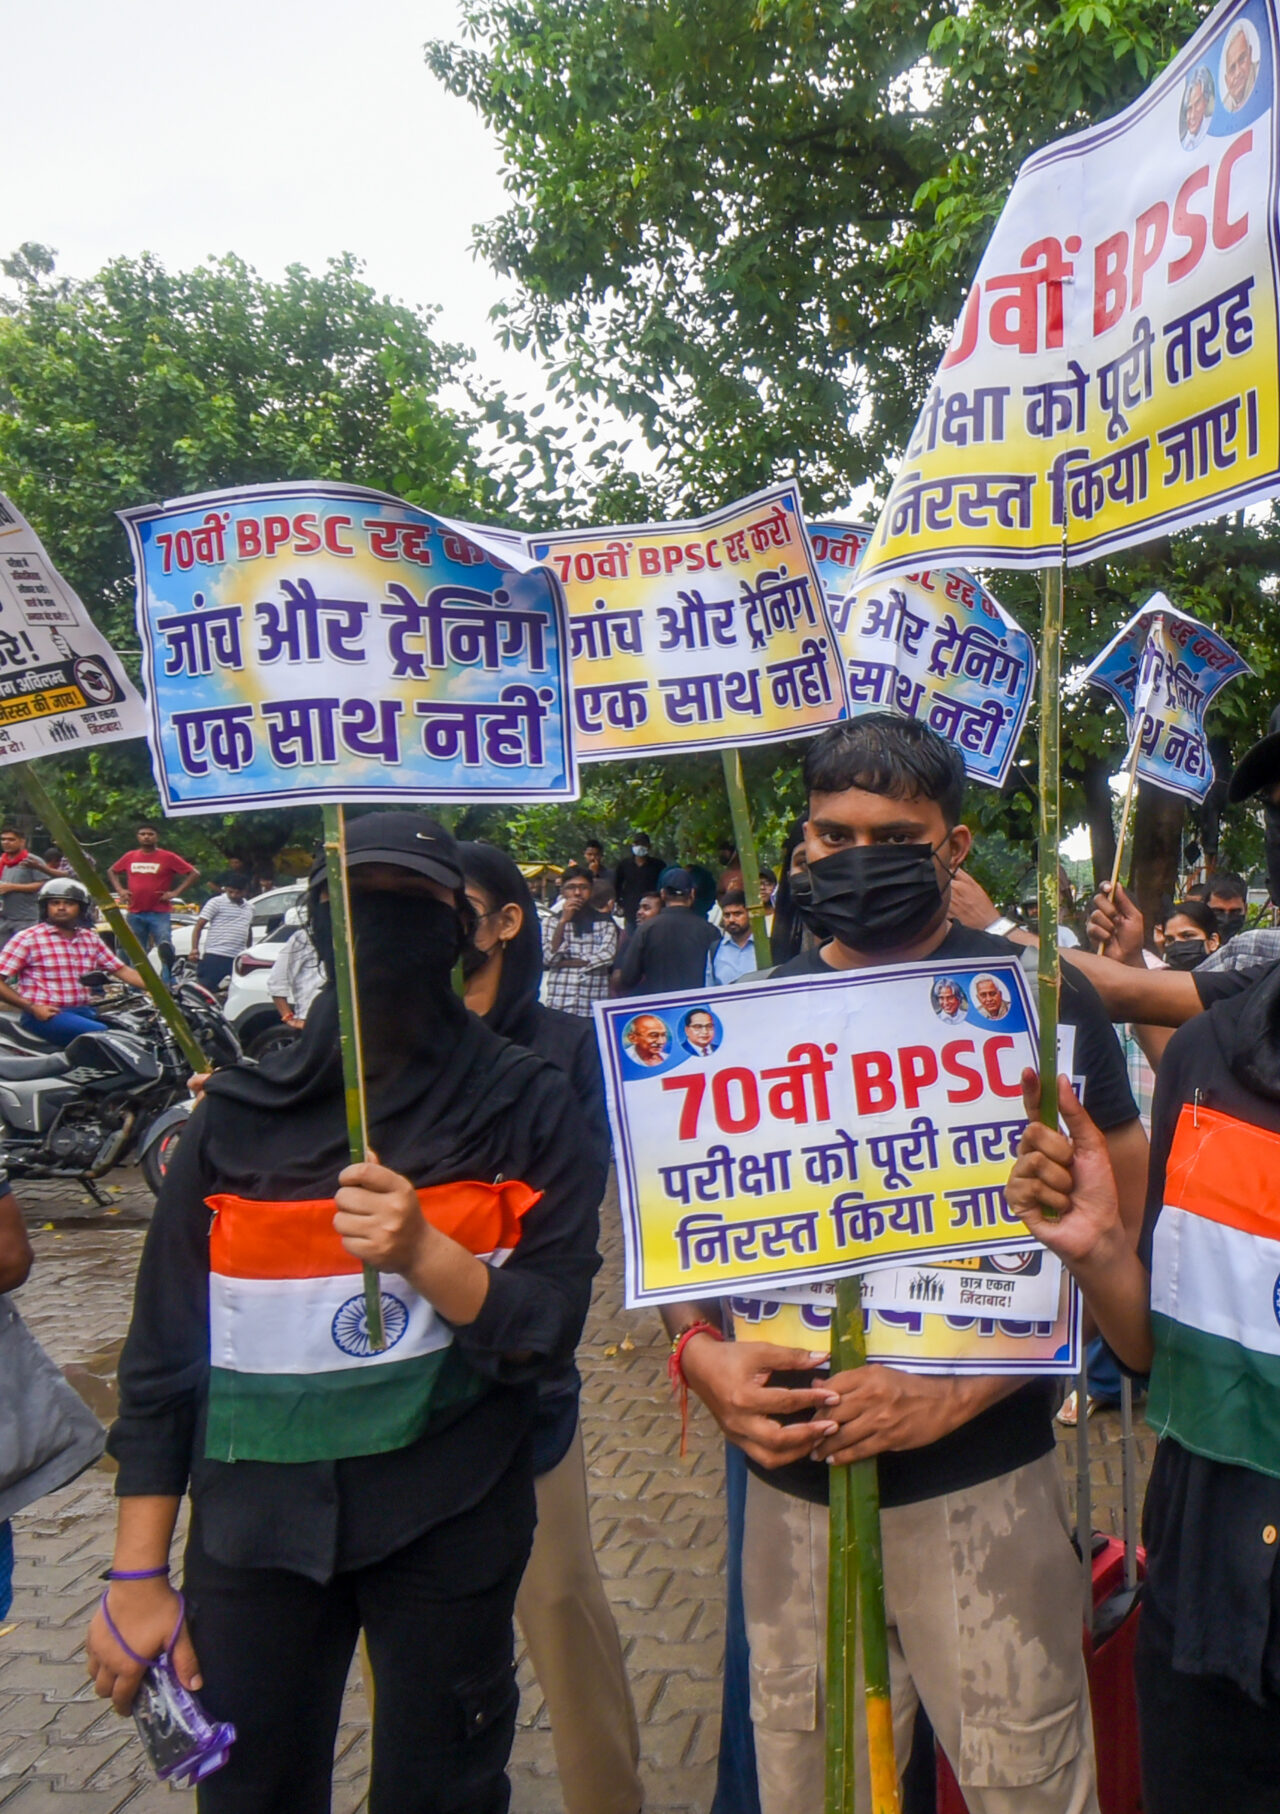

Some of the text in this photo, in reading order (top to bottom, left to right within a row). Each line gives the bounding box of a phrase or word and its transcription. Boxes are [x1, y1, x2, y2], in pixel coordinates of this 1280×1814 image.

[943, 130, 1253, 371] वीं BPSC
[908, 276, 1255, 460] रीक्षा को पूरी तरह
[880, 471, 1037, 547] निरस्त
[1047, 440, 1149, 525] किया
[155, 511, 231, 575] 70वीं
[237, 513, 354, 558] BPSC
[363, 519, 431, 567] रद्द
[553, 506, 792, 583] 70वीं BPSC रद्द करो
[811, 534, 867, 567] 0वीं
[157, 578, 549, 680] जांच और ट्रेनिंग
[570, 599, 643, 661] जांच
[656, 589, 737, 652] और
[739, 565, 817, 649] ट्रेनिंग
[860, 587, 930, 656] और
[928, 614, 1026, 697] ट्रेनिंग
[172, 684, 555, 776] एक साथ नहीं
[575, 637, 833, 734] एक साथ नहीं
[929, 690, 1015, 758] नहीं
[1165, 722, 1207, 778] नही
[661, 1035, 1024, 1142] 70वीं BPSC
[658, 1144, 792, 1207] परीक्षा
[801, 1128, 858, 1188] को
[867, 1116, 940, 1191] पूरी
[674, 1184, 1022, 1272] निरस्त किया जा
